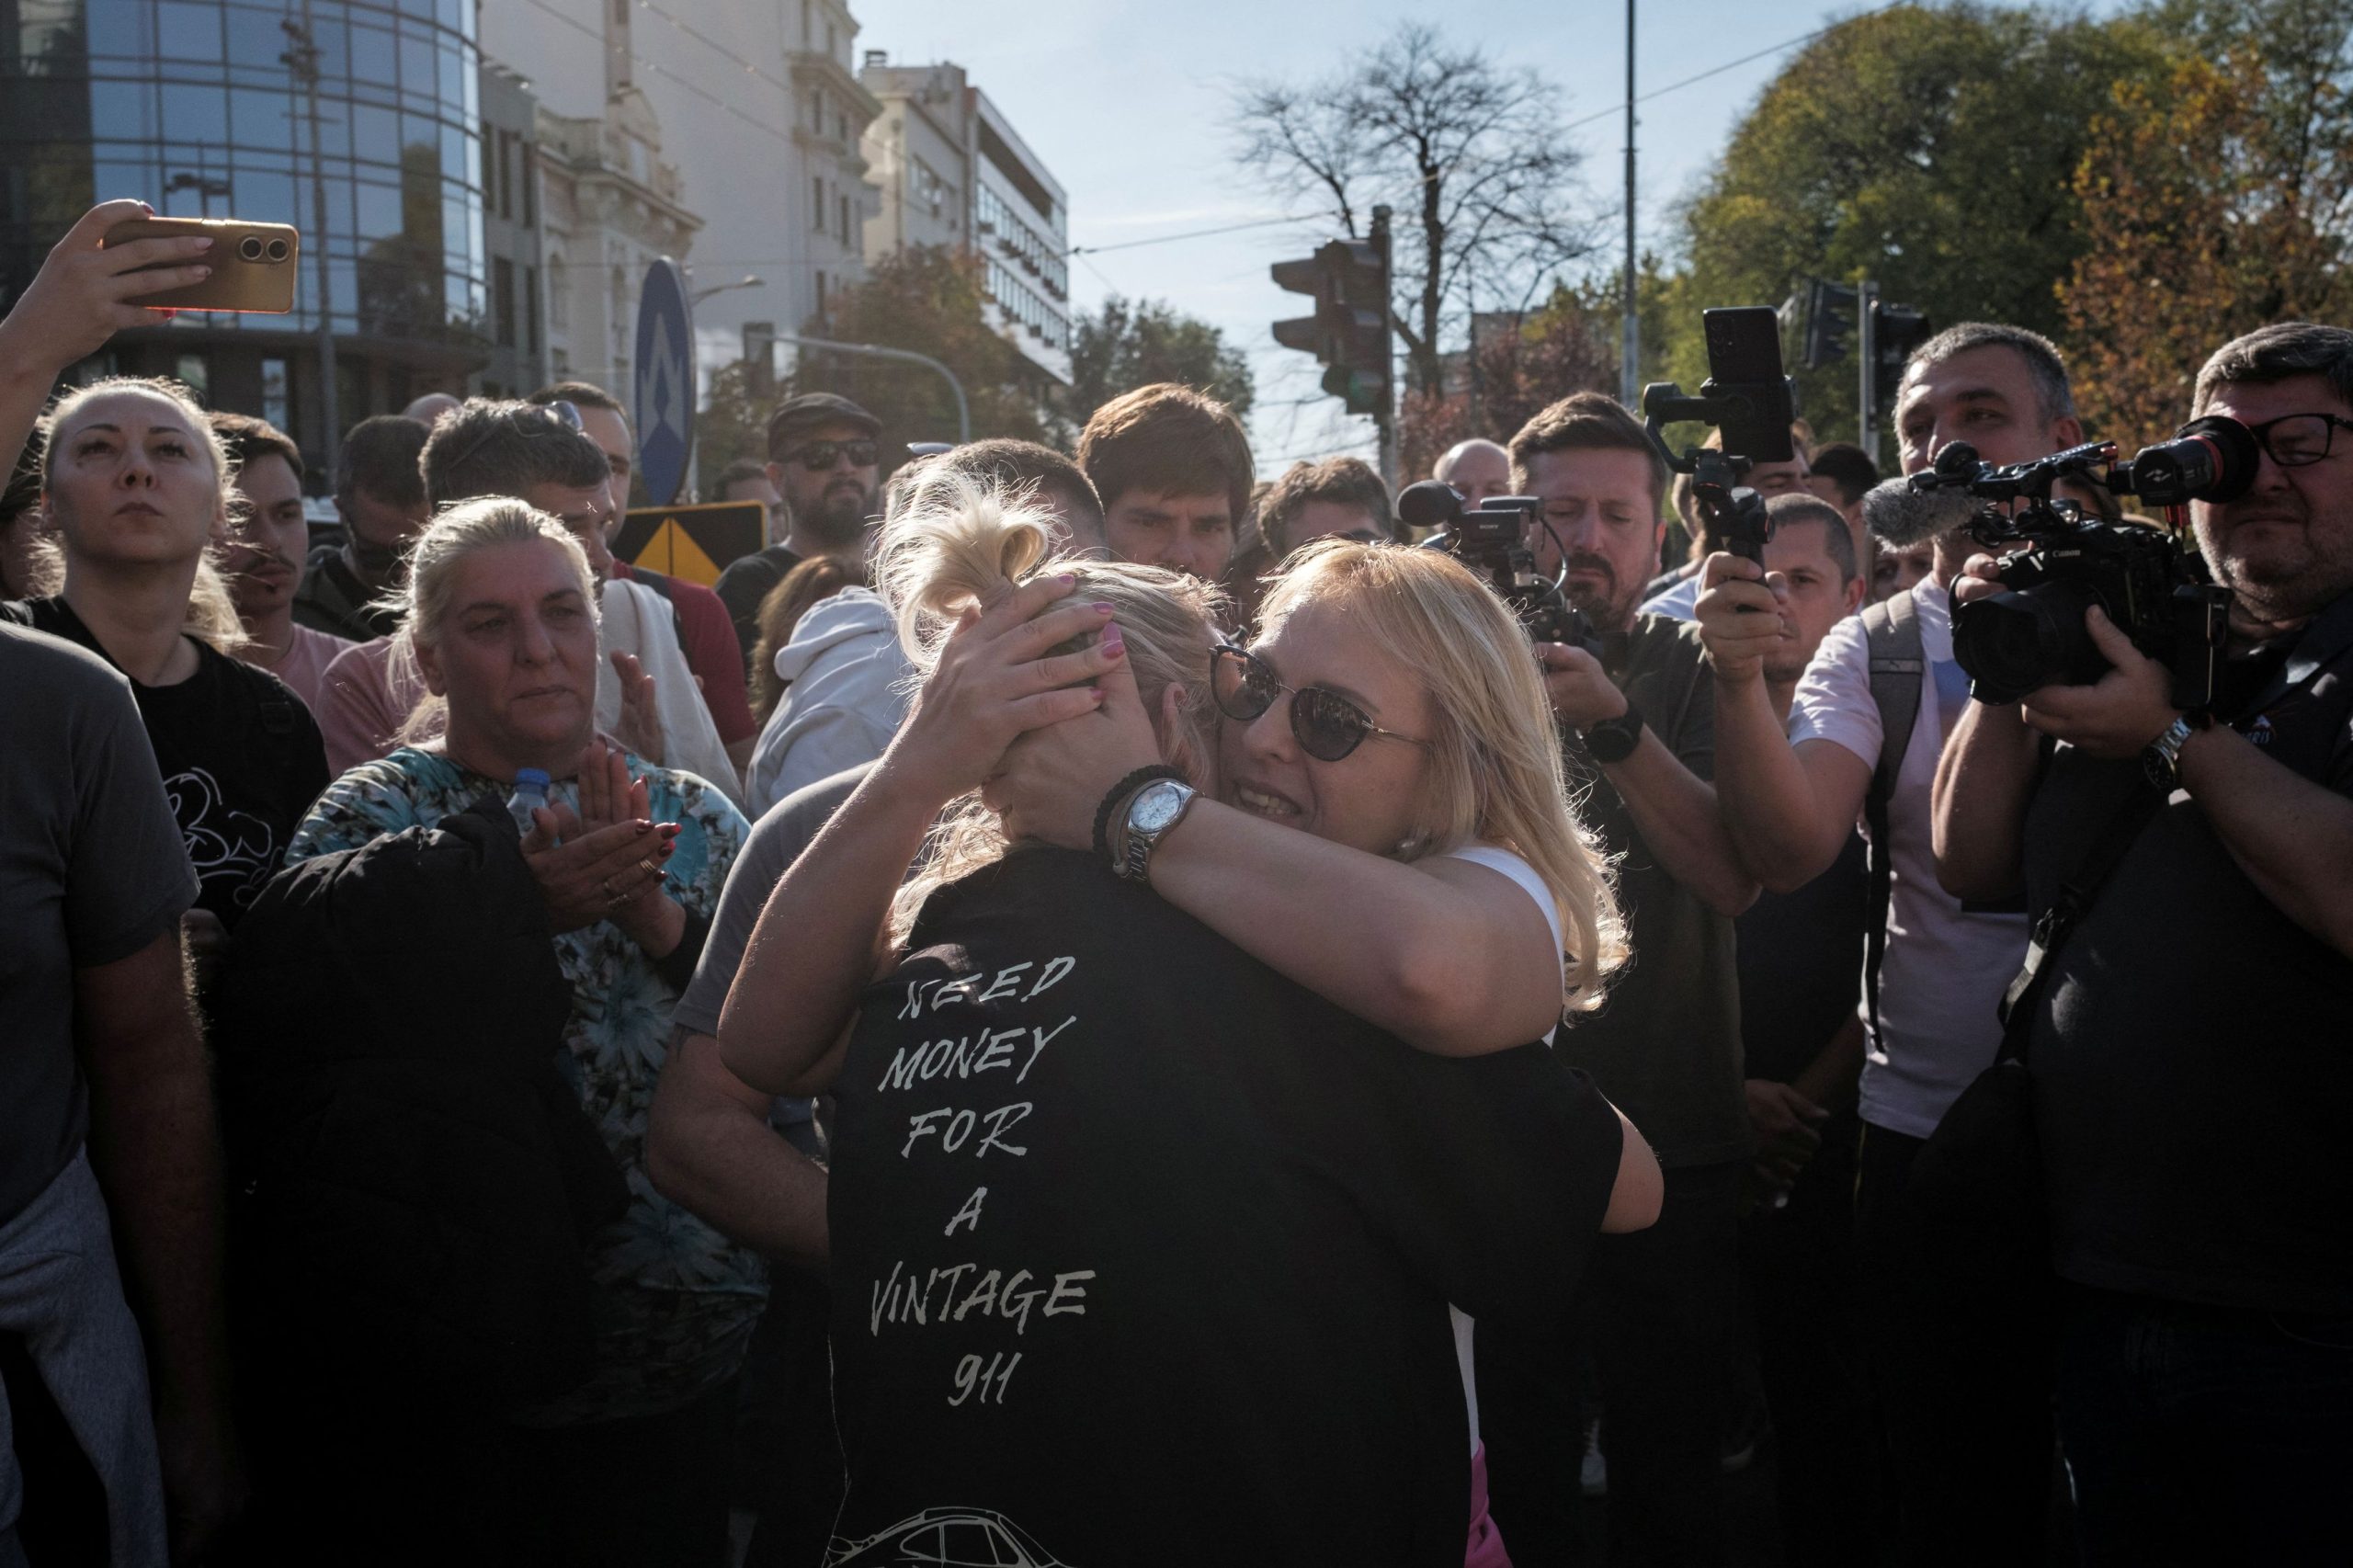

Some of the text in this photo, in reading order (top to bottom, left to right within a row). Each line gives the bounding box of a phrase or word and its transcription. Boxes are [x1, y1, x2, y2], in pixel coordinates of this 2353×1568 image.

[2052, 550, 2081, 558] Canon
[897, 955, 1076, 1019] NEED
[877, 1016, 1077, 1093] MONEY
[901, 1101, 1033, 1158] FOR
[944, 1186, 988, 1236] A
[870, 1260, 1097, 1337] VINTAGE
[948, 1351, 1023, 1406] 911
